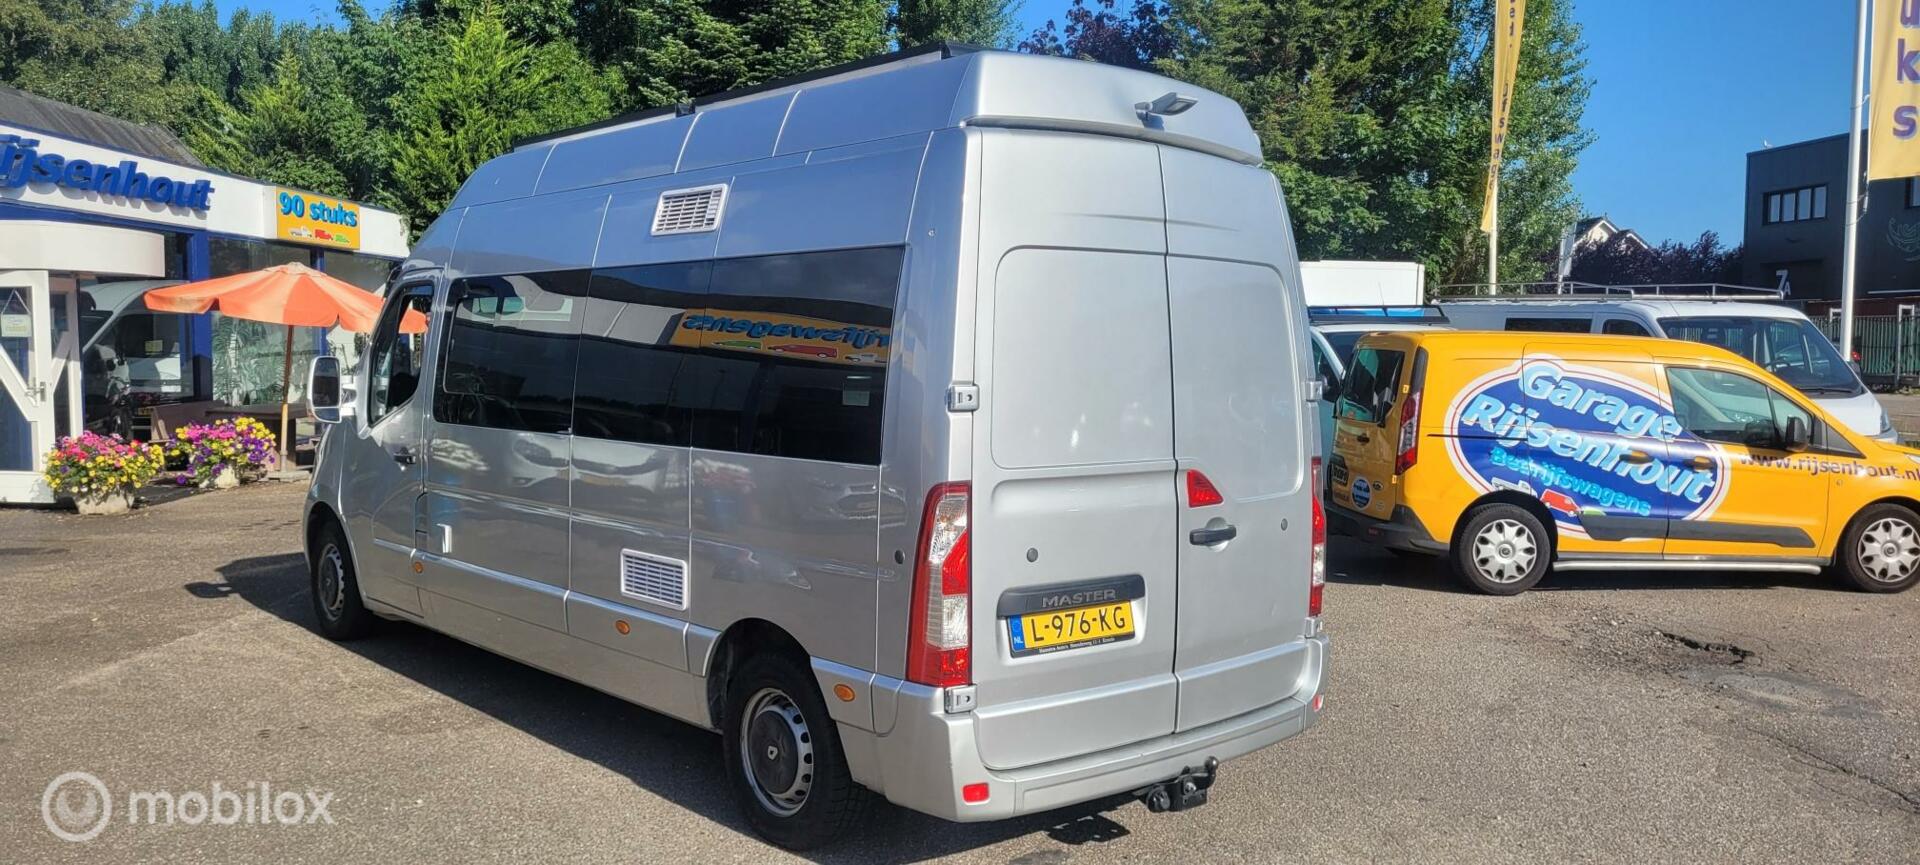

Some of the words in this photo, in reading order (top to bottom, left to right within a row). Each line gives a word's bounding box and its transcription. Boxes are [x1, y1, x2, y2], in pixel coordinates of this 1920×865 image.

[279, 192, 304, 218] 90
[310, 201, 357, 227] stuks
[1518, 364, 1683, 443] Garage
[1461, 393, 1715, 503] Rijsenhout
[1489, 446, 1651, 516] Bedrijfswagens
[1739, 453, 1920, 481] www.rijsenhout.nl
[1042, 589, 1116, 608] MASTER
[1013, 636, 1024, 645] NL
[1031, 606, 1125, 642] L-976-KG
